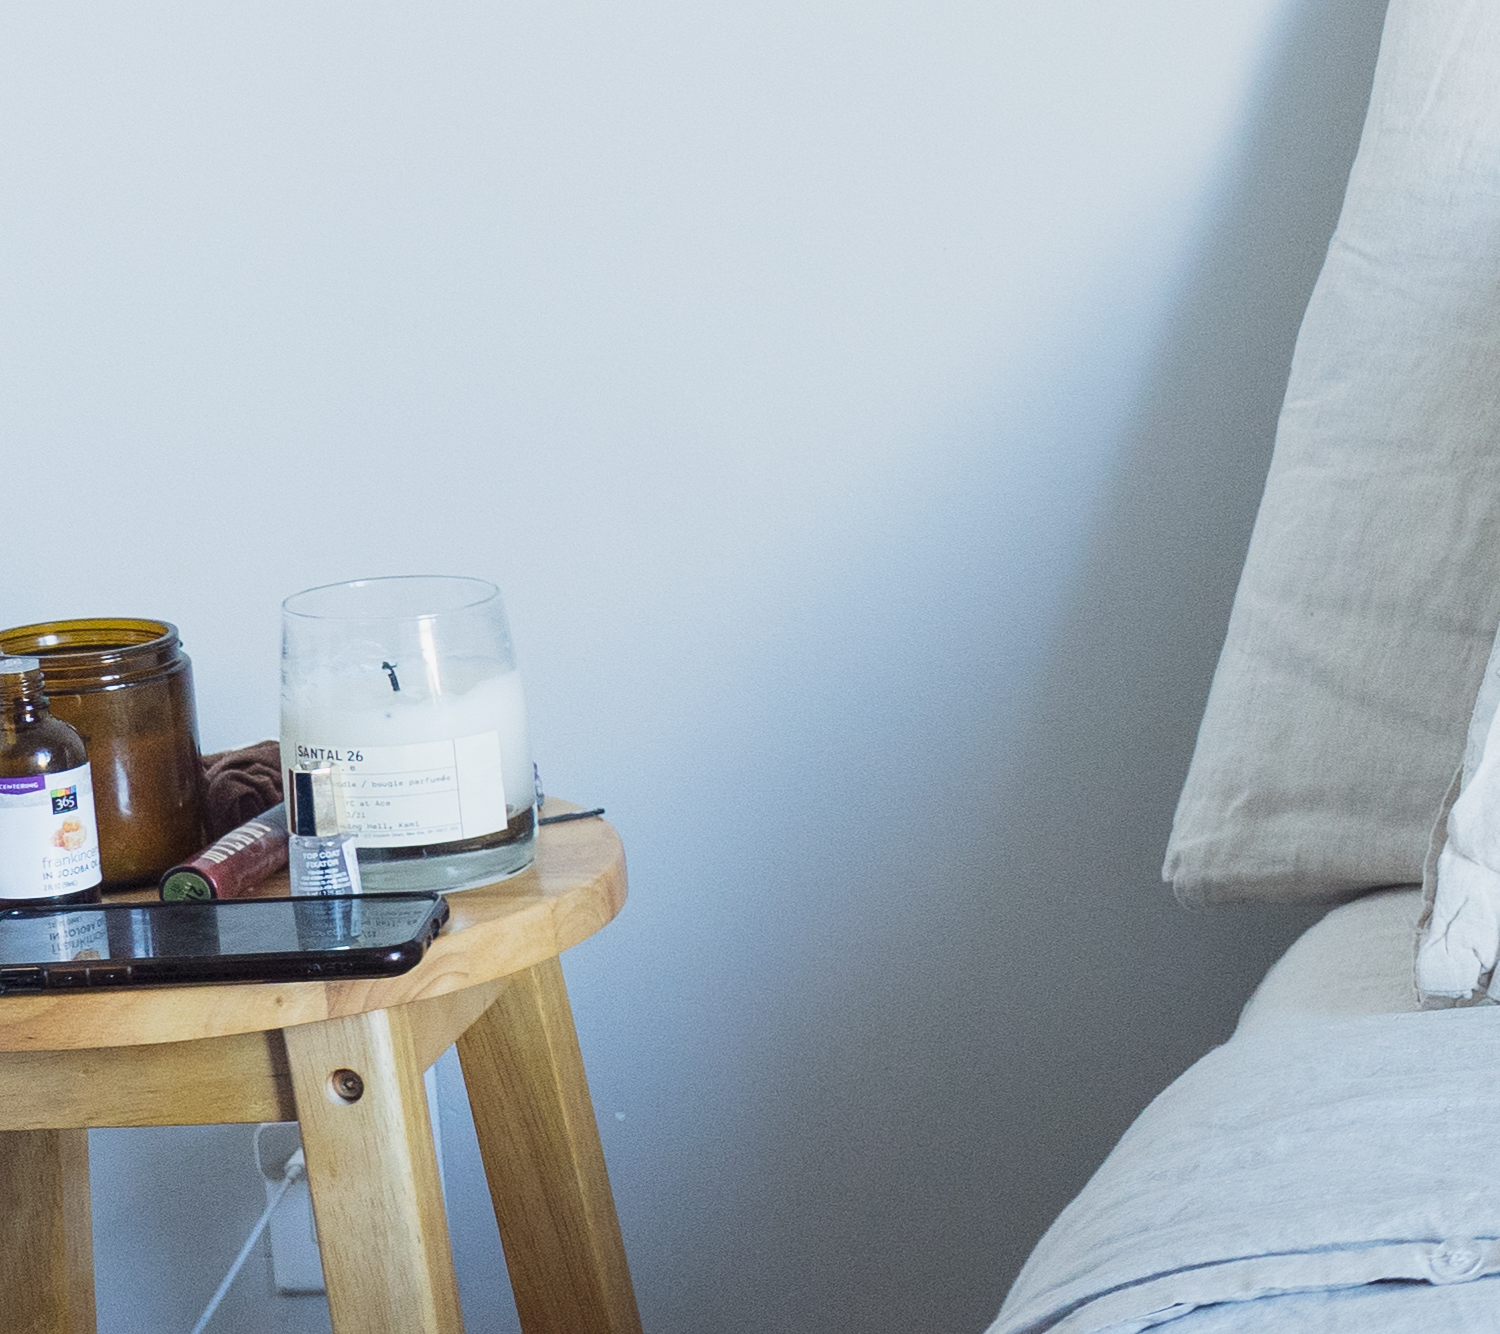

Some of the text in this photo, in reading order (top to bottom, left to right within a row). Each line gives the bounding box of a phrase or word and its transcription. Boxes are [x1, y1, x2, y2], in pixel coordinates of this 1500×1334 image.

[297, 746, 364, 762] SANTAL 26
[372, 780, 404, 789] bougie
[55, 795, 75, 811] 365
[42, 846, 98, 869] frankince
[319, 849, 340, 859] COAT
